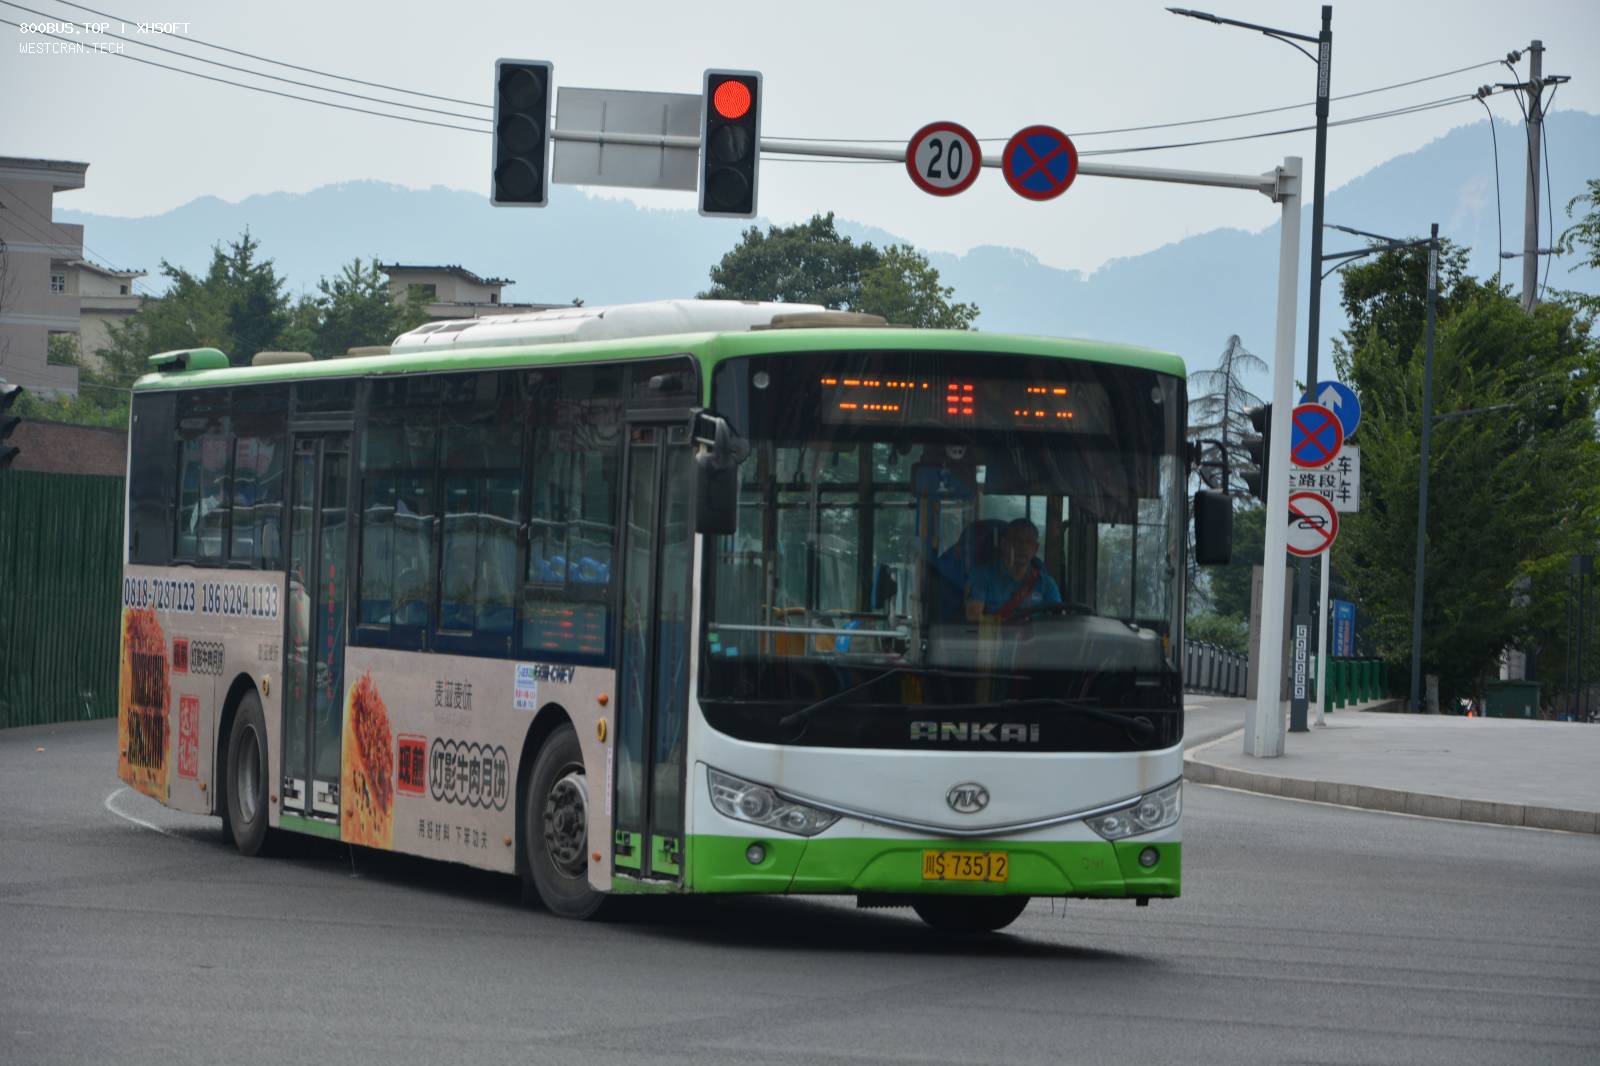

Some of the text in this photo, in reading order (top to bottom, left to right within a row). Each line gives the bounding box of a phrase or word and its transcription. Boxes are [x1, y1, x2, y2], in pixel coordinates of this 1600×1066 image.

[927, 138, 963, 180] 20
[124, 577, 195, 610] 0818-7287123
[432, 750, 507, 800] 灯影牛肉月饼
